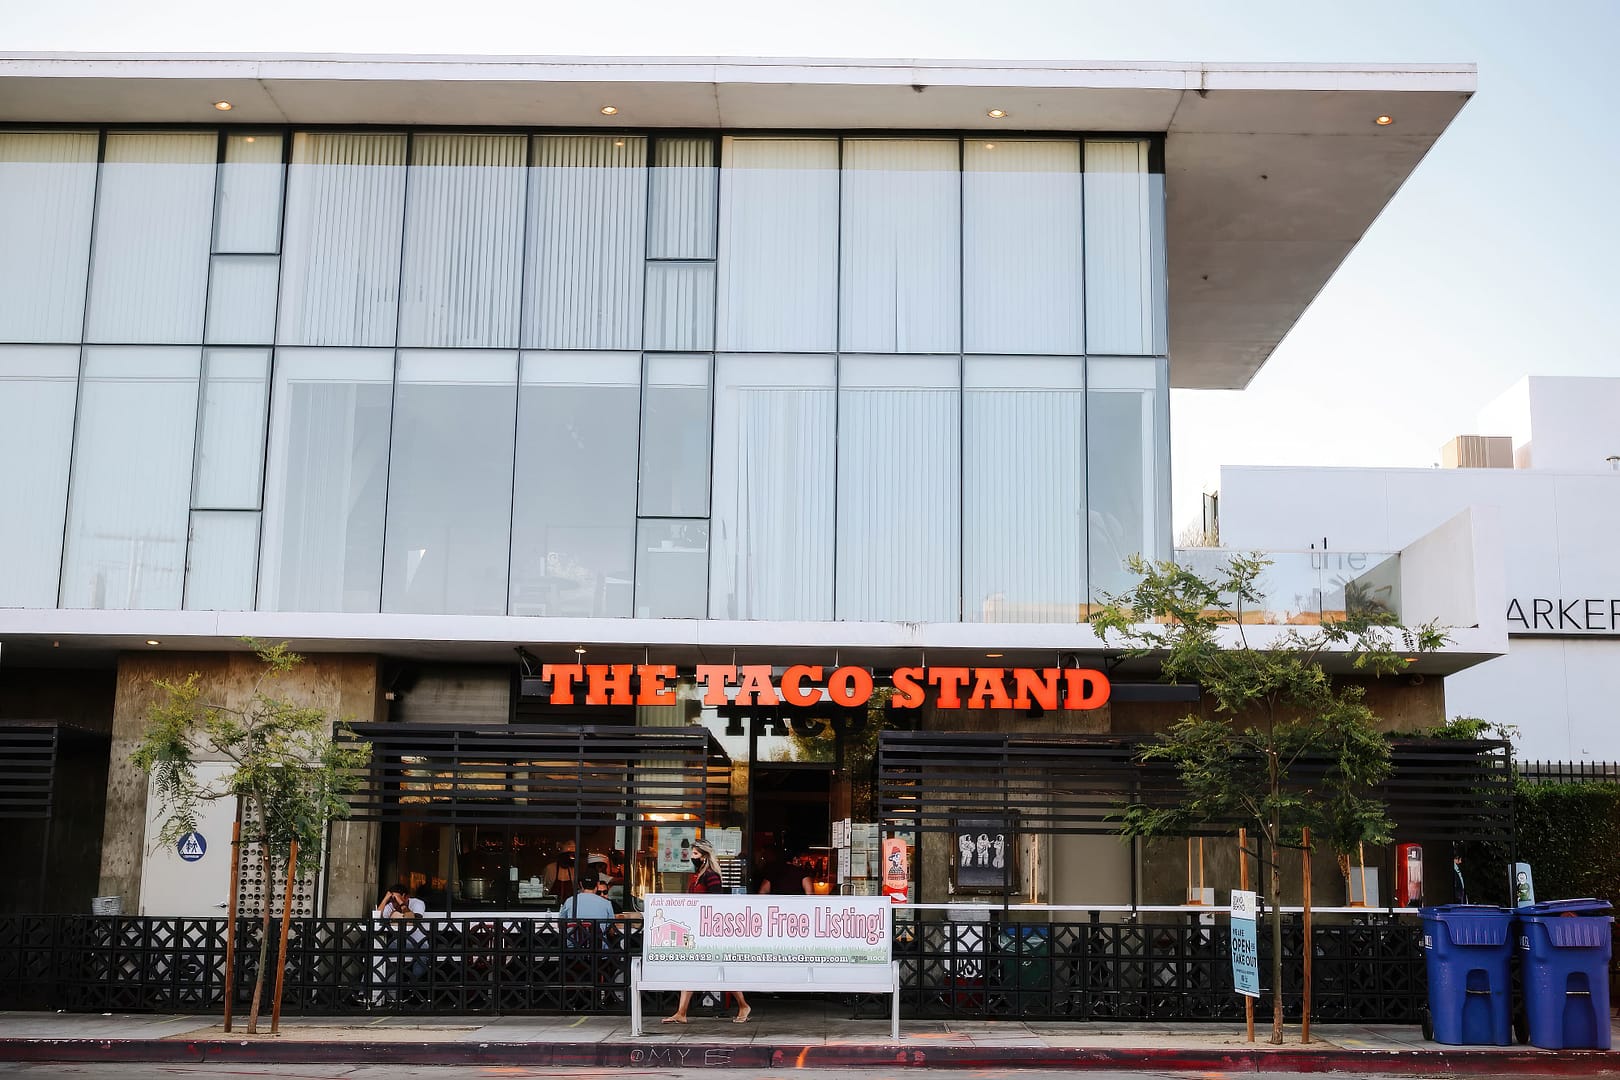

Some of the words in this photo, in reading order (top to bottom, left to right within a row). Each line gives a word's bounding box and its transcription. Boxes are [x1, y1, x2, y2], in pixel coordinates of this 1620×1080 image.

[542, 663, 677, 706] THE
[696, 664, 874, 708] TACO
[892, 667, 1112, 711] STAND
[650, 897, 663, 907] Ask
[665, 897, 685, 907] about
[687, 898, 699, 907] our
[699, 905, 763, 938] Hassle
[767, 905, 810, 938] Free
[814, 906, 885, 946] Listing!
[1232, 937, 1251, 954] OPEN
